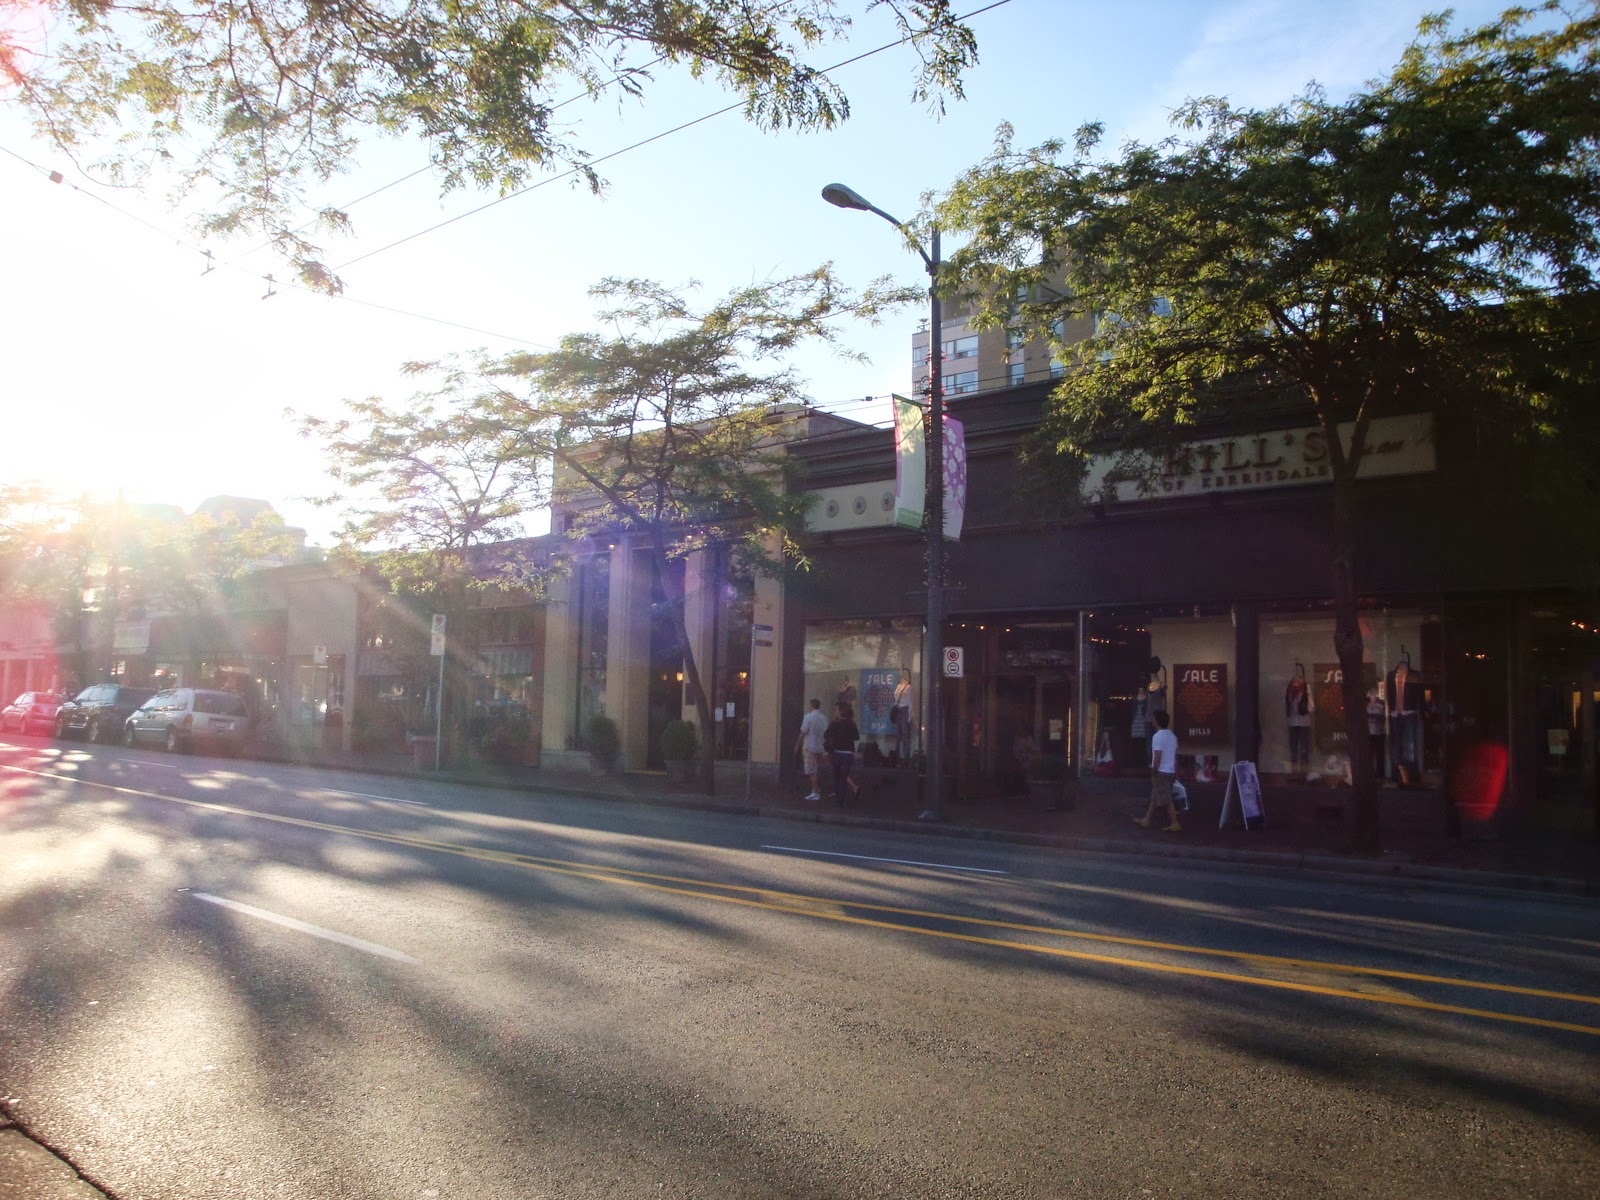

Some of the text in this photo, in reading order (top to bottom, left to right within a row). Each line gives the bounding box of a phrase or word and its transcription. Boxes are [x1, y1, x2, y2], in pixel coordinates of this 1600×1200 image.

[1161, 433, 1327, 477] HILL'S
[1202, 466, 1329, 489] KERRISDALE
[867, 674, 893, 685] SALE
[1182, 669, 1218, 683] SALE
[1324, 670, 1343, 683] SA
